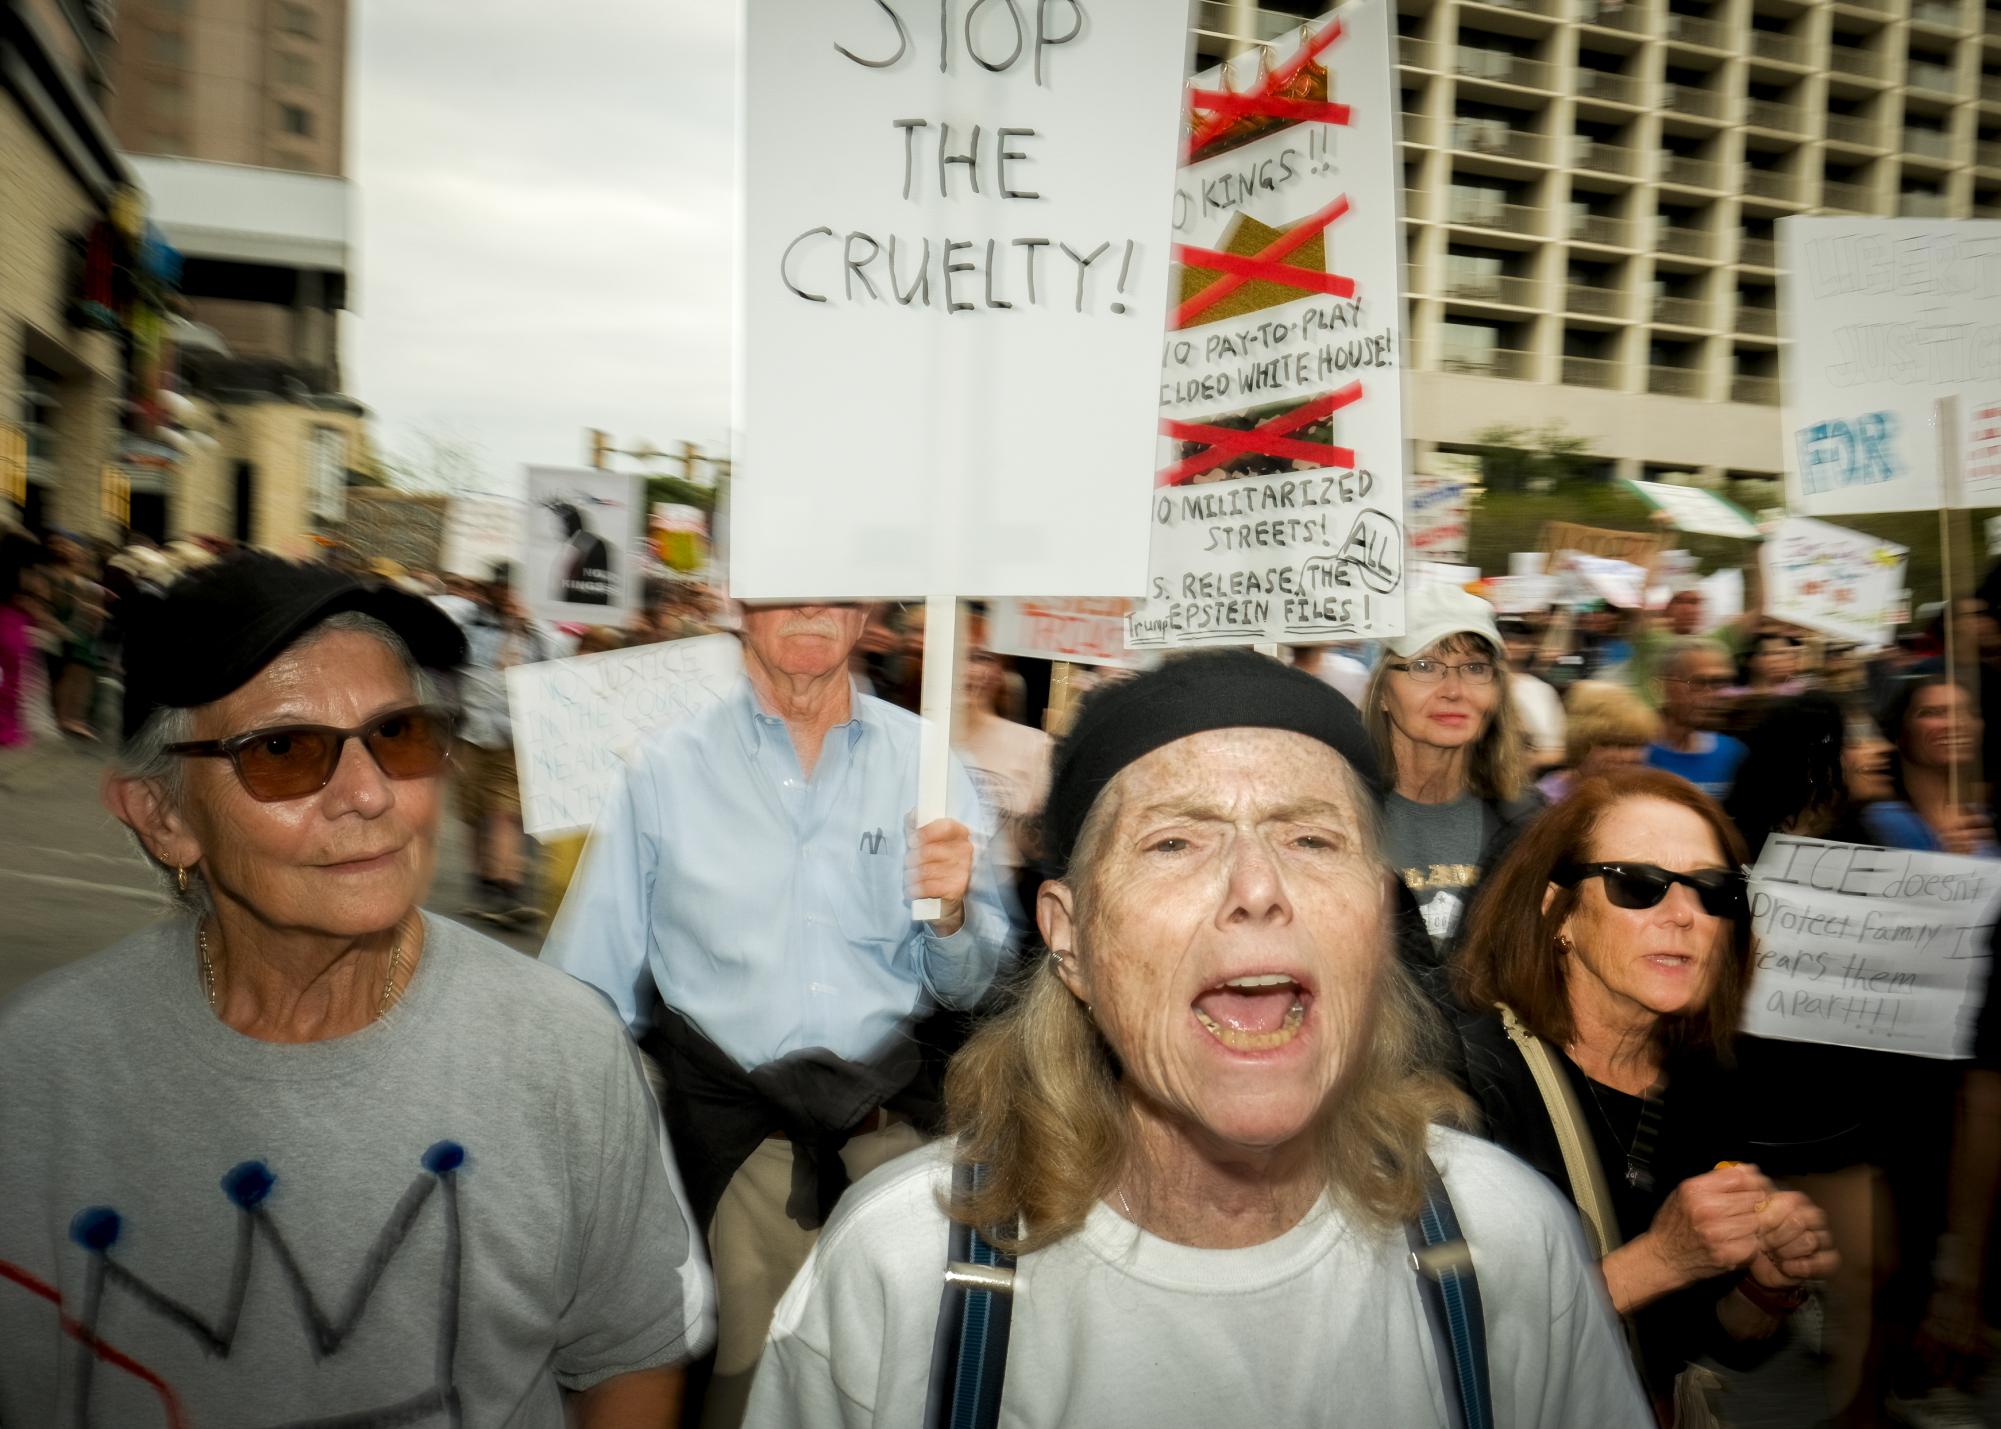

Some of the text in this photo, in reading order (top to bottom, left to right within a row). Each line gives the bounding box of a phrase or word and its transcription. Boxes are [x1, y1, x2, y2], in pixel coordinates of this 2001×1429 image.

[892, 118, 1040, 199] THE
[1172, 188, 1189, 230] O
[780, 225, 1134, 315] CRUELTY!
[1160, 327, 1393, 406] ILDED WHITE HOUSE!
[1795, 408, 1897, 497] FOR
[1152, 495, 1171, 524] O
[1181, 470, 1373, 521] MILITARIZED
[1204, 514, 1330, 552] STREETS!
[1344, 521, 1393, 577] ALL
[1183, 566, 1292, 599] RELEASE
[1306, 561, 1352, 589] THE
[1127, 612, 1168, 639] Trump
[1169, 600, 1269, 630] EPSTEIN
[1762, 840, 1888, 897] ICE
[1843, 953, 1917, 994] them
